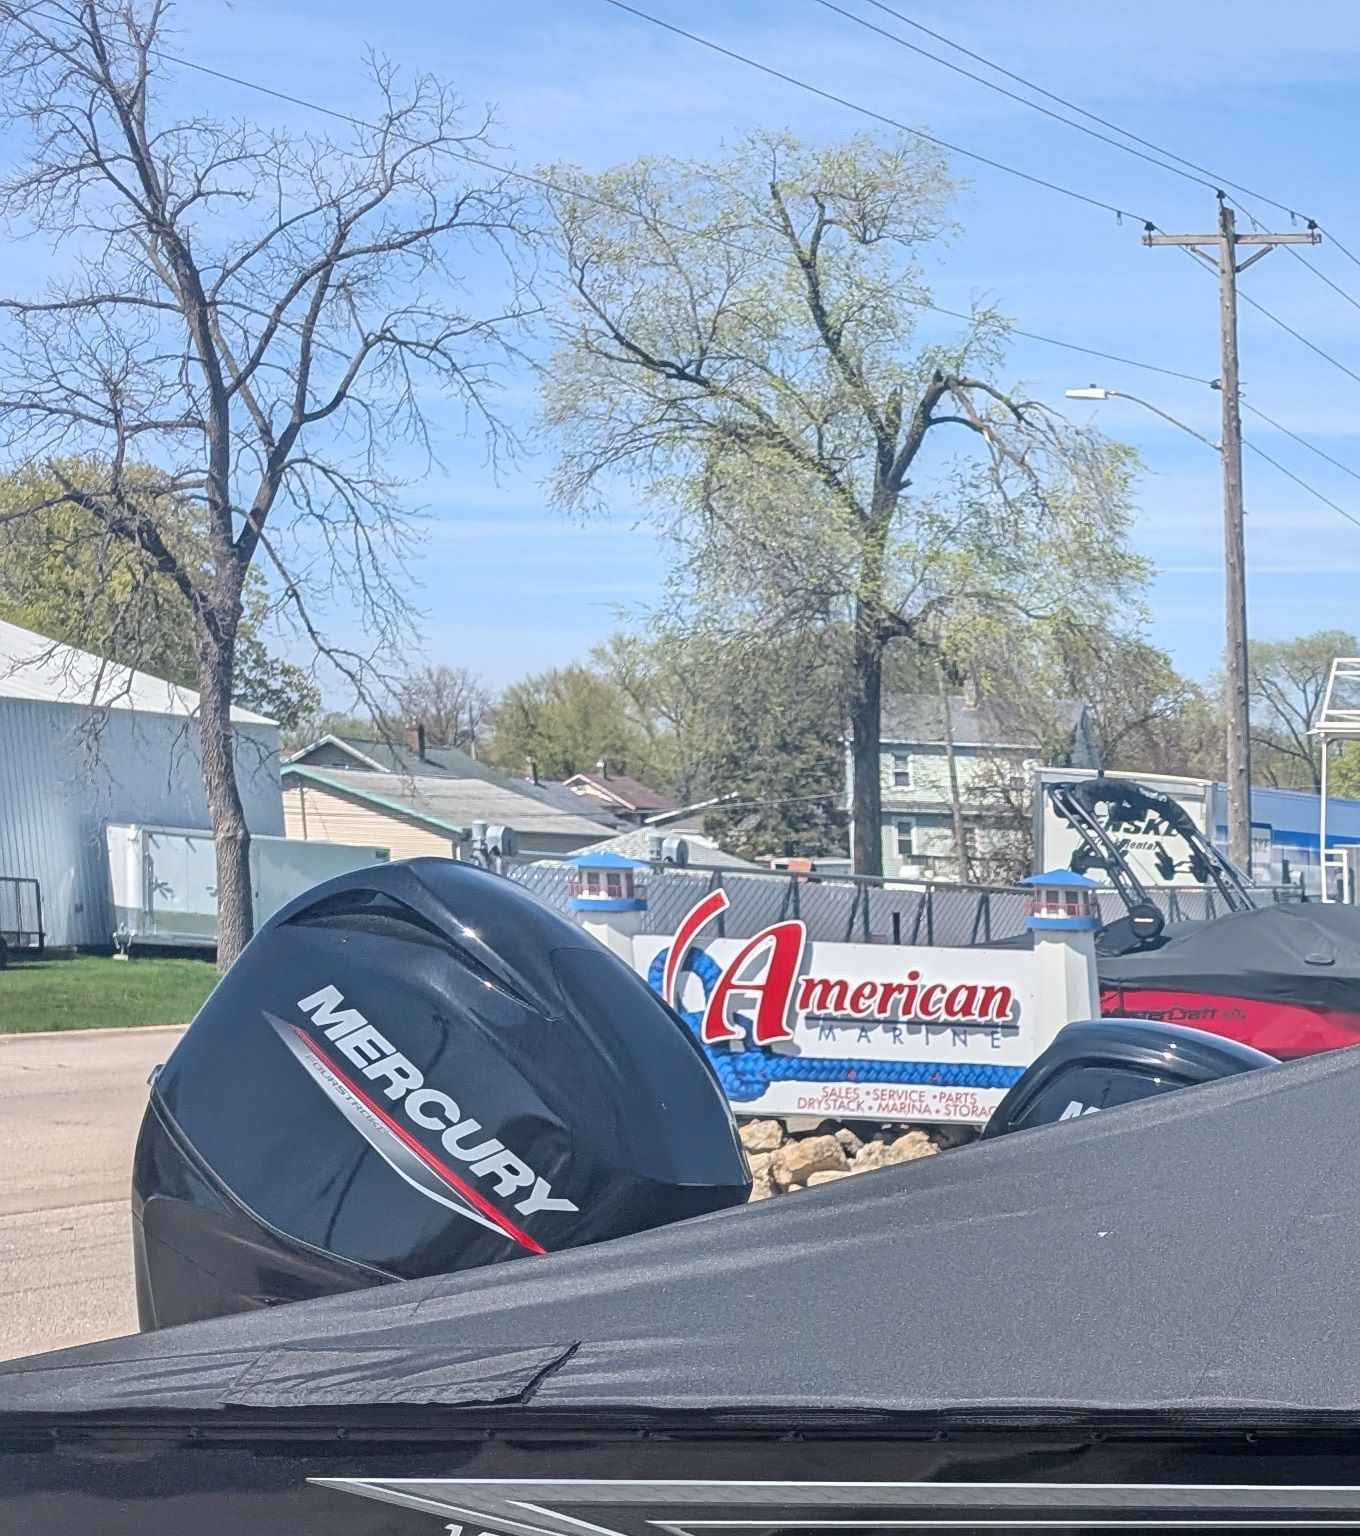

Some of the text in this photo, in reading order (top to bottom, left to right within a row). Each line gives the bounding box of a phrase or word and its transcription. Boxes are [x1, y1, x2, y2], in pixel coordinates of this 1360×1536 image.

[690, 905, 1014, 1044] American
[818, 1023, 1002, 1050] MARINE
[296, 983, 580, 1217] MERCURY
[797, 1097, 998, 1118] DRYSTACK MARINA STORA
[821, 1086, 977, 1105] SALES SERVICE PARTS
